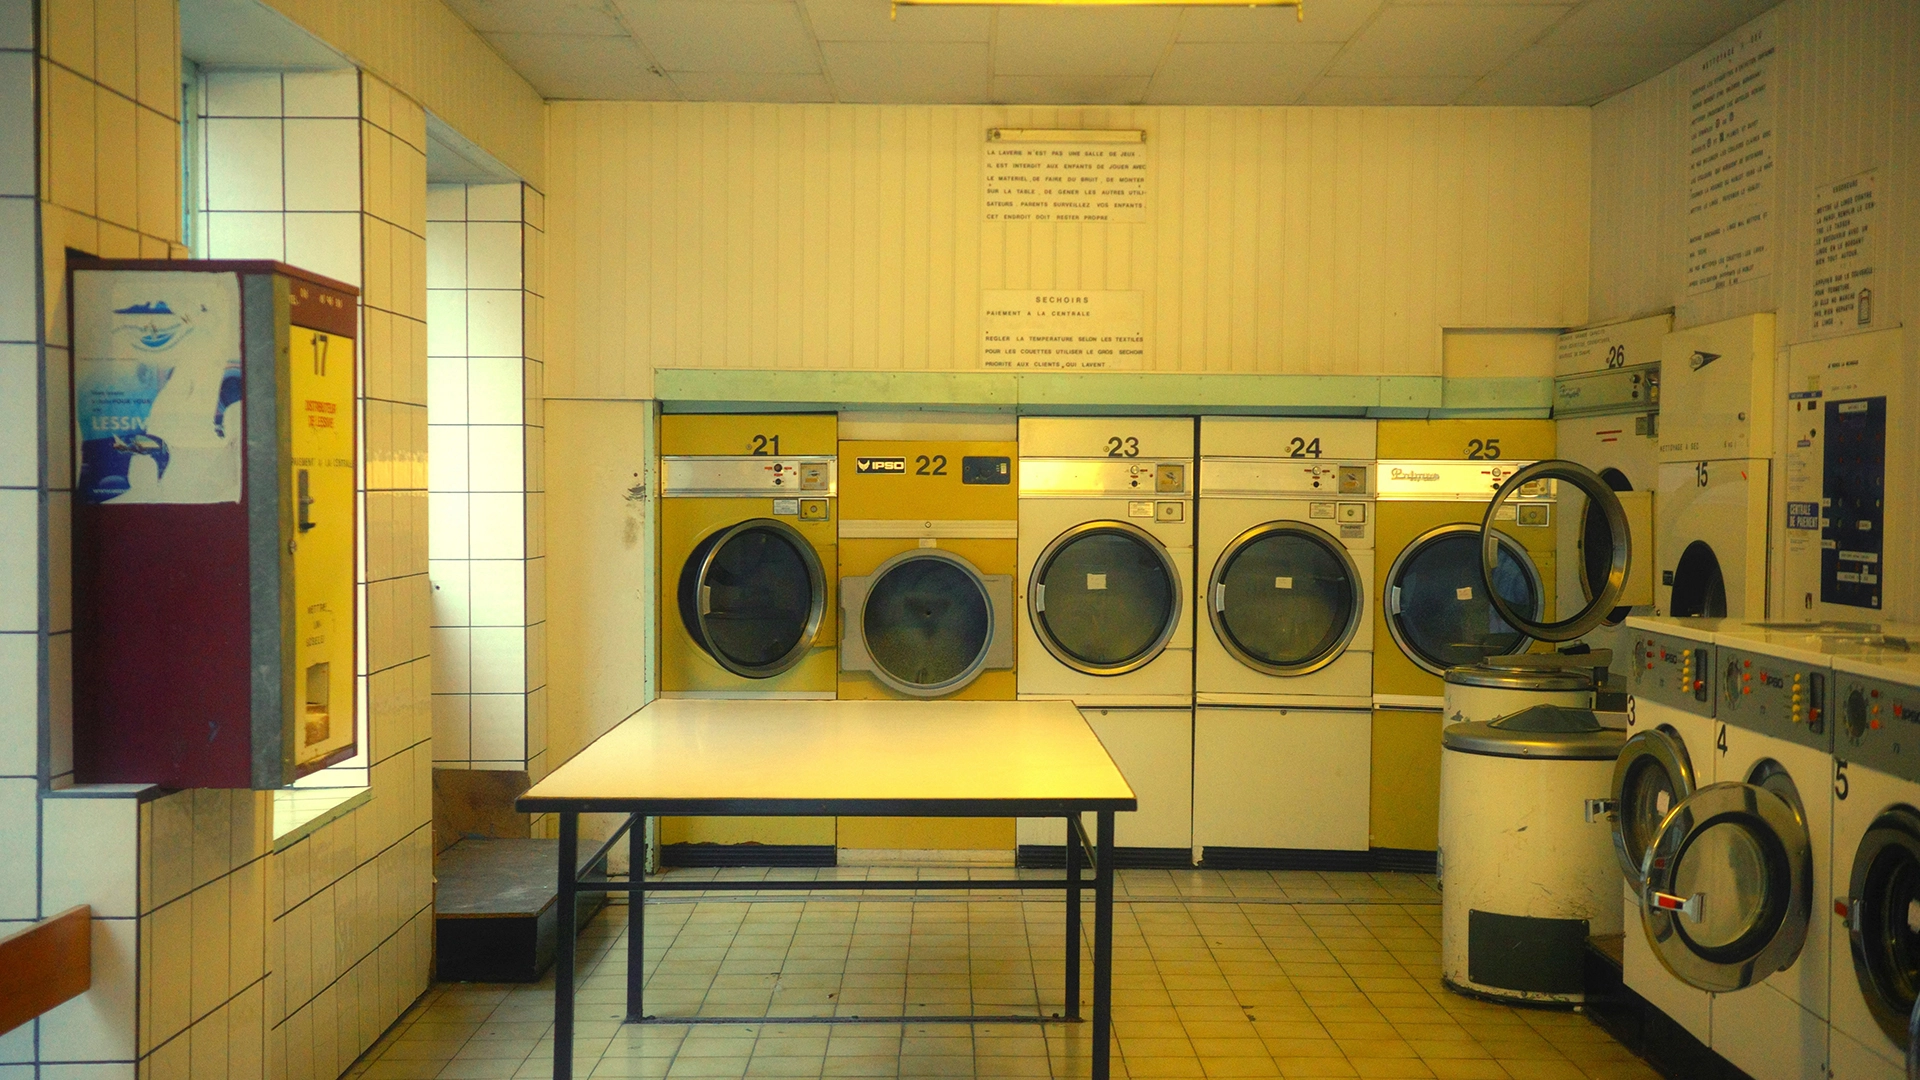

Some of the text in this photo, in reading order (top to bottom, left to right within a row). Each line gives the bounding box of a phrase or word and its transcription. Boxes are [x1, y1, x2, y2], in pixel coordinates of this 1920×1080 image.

[1036, 296, 1089, 304] SECHOIRS
[310, 332, 328, 376] 17
[1609, 344, 1624, 369] 26
[753, 435, 779, 456] 21
[1107, 437, 1139, 457] 23
[1290, 437, 1322, 458] 24
[1468, 439, 1500, 460] 25
[872, 455, 947, 475] IPSO 22
[1695, 461, 1708, 487] 15
[1627, 695, 1636, 726] 3
[1717, 724, 1728, 758] 4
[1835, 760, 1849, 800] 5
